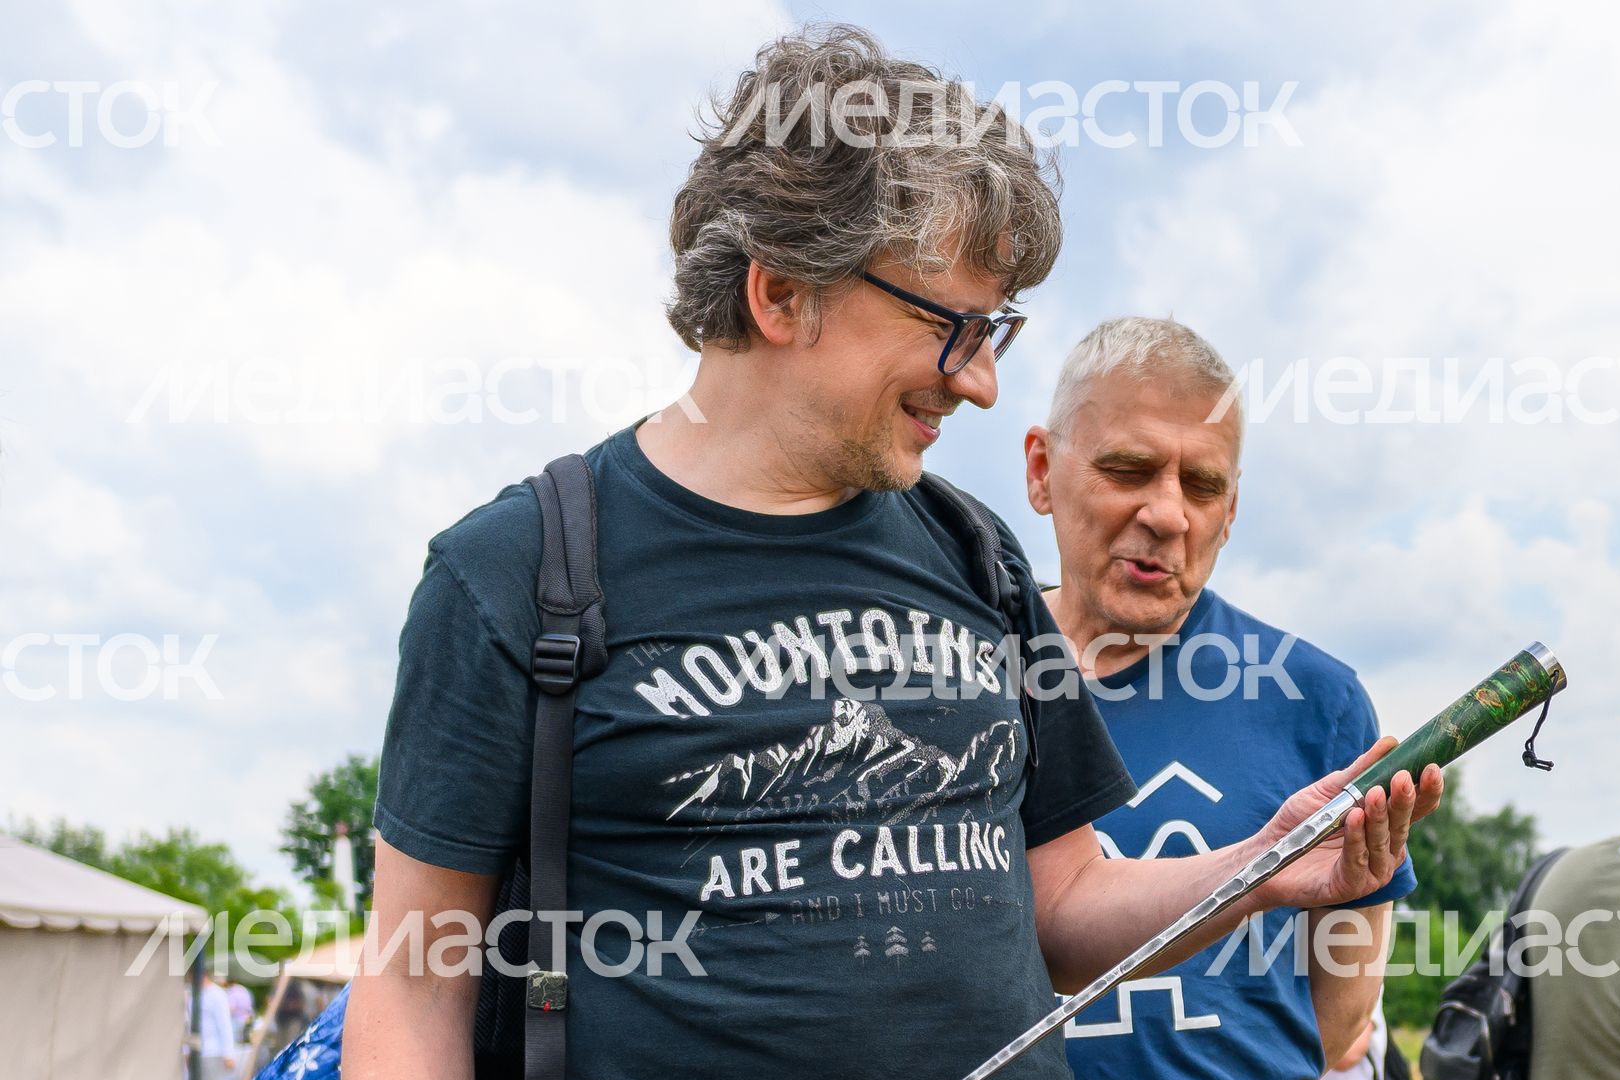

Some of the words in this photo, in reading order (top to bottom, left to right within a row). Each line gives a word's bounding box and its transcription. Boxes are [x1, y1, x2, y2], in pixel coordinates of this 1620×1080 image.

[634, 608, 1001, 717] MOUNTAINS
[700, 839, 804, 901] ARE
[831, 821, 1010, 880] CALLING
[790, 895, 841, 924] AND
[853, 892, 864, 917] I
[876, 888, 937, 915] MUST
[951, 887, 975, 911] GO
